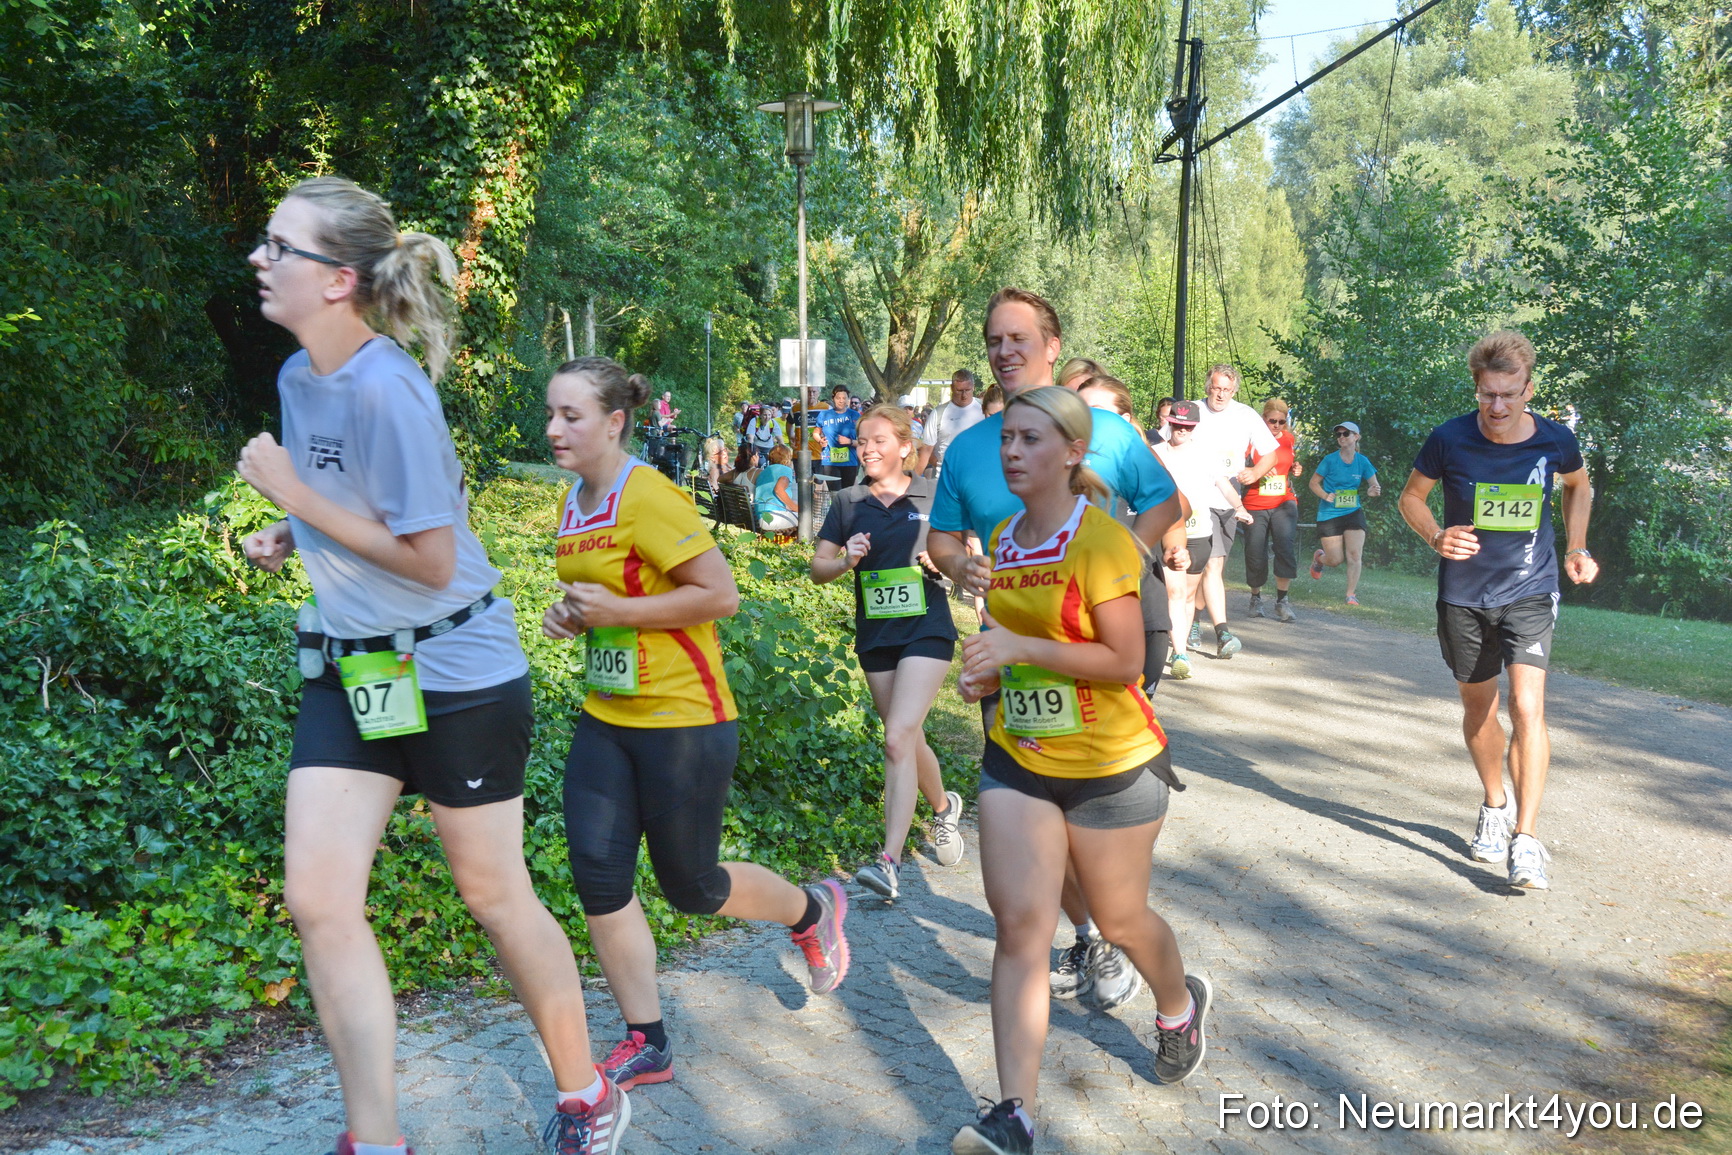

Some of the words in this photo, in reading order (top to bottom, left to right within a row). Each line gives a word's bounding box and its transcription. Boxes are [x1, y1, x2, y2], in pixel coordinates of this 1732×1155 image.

[1263, 482, 1283, 491] 1152
[1338, 495, 1355, 503] 1541
[1482, 500, 1533, 518] 2142
[578, 534, 618, 554] BÖGL
[1019, 569, 1064, 589] BÖGL
[874, 585, 909, 605] 375
[1005, 689, 1063, 715] 1319
